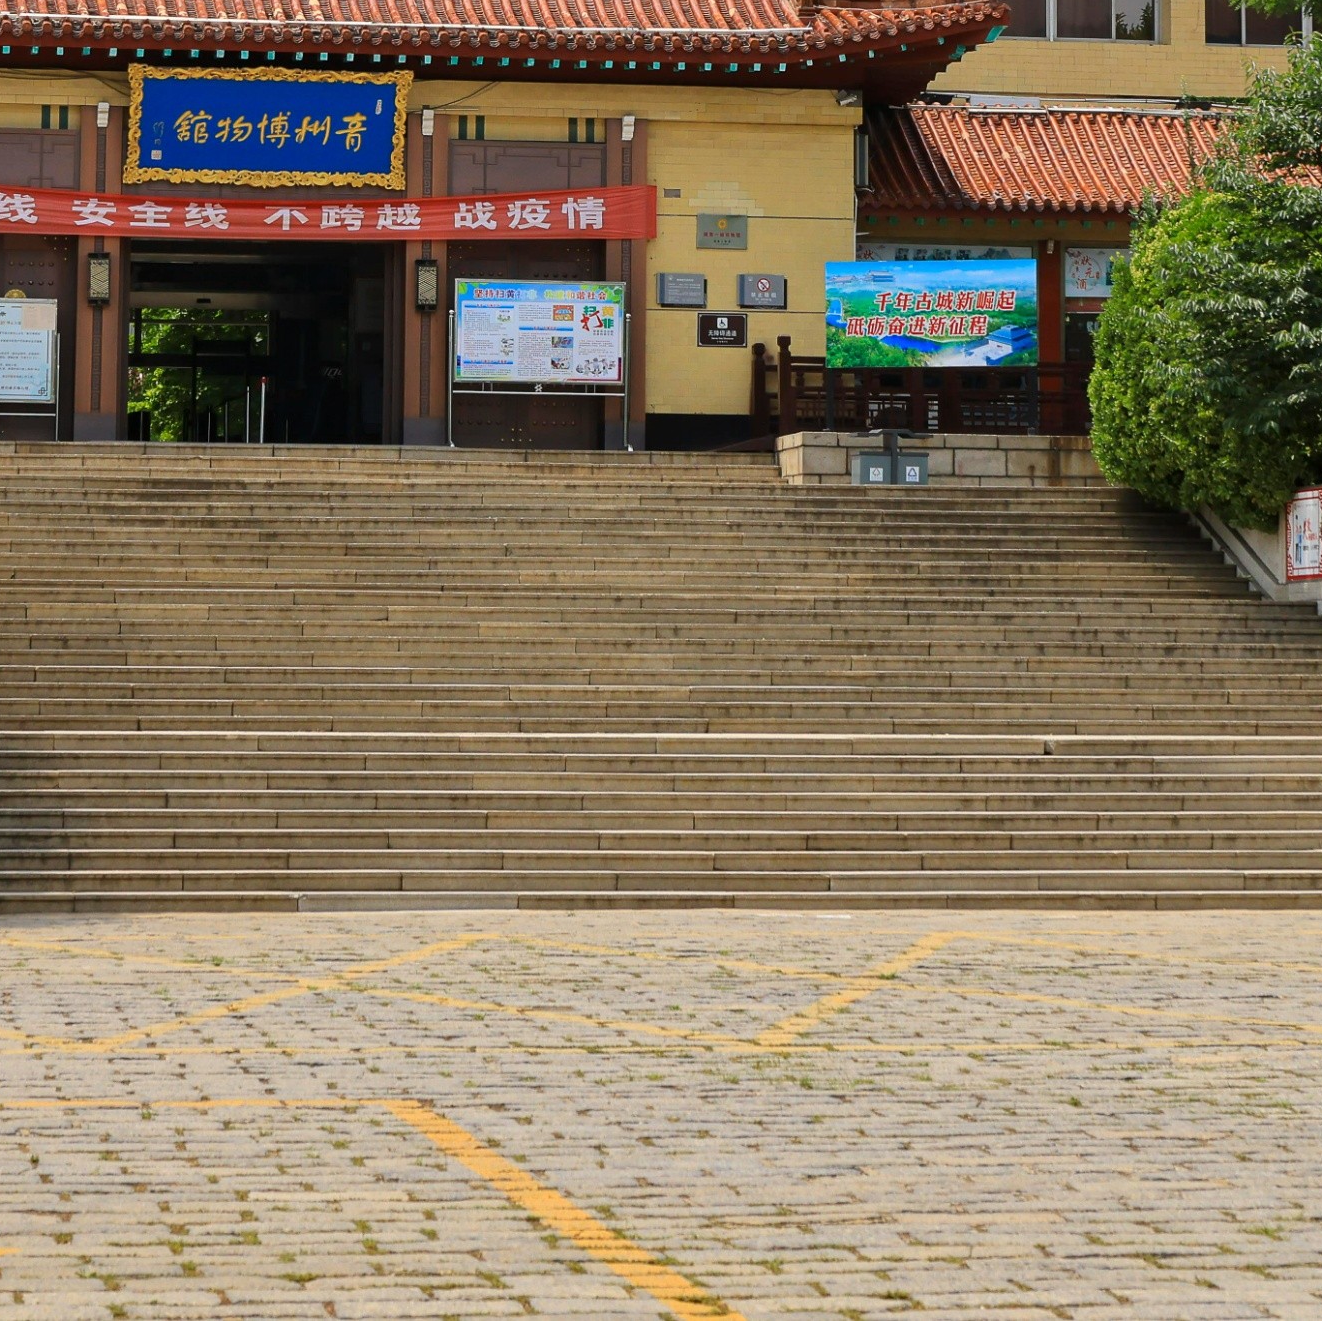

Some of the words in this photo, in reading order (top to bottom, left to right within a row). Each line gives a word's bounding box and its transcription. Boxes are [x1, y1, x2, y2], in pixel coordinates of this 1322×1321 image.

[72, 198, 230, 230] 安全线
[263, 204, 422, 231] 不跨越
[453, 197, 606, 231] 战疫情
[874, 290, 1016, 312] 千年古城新崛起
[846, 315, 989, 337] 砥砺奋进新征程
